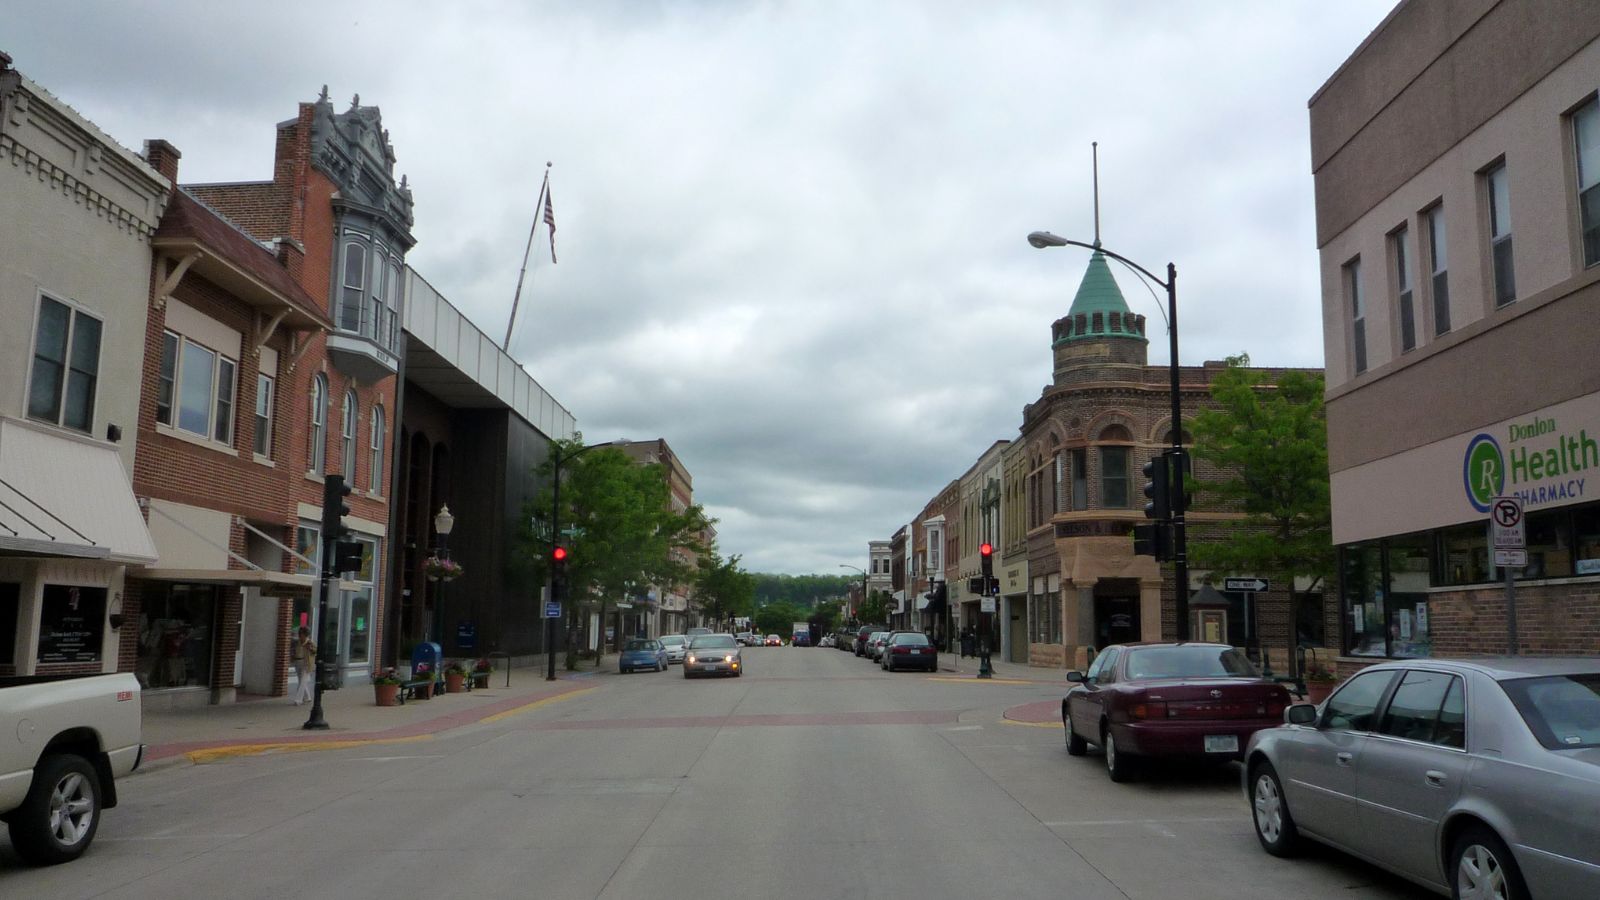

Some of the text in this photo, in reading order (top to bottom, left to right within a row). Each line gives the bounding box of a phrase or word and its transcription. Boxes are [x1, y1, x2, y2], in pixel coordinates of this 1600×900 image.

[1508, 416, 1556, 443] Donlon
[1510, 429, 1599, 484] Health
[117, 690, 133, 700] HEMI
